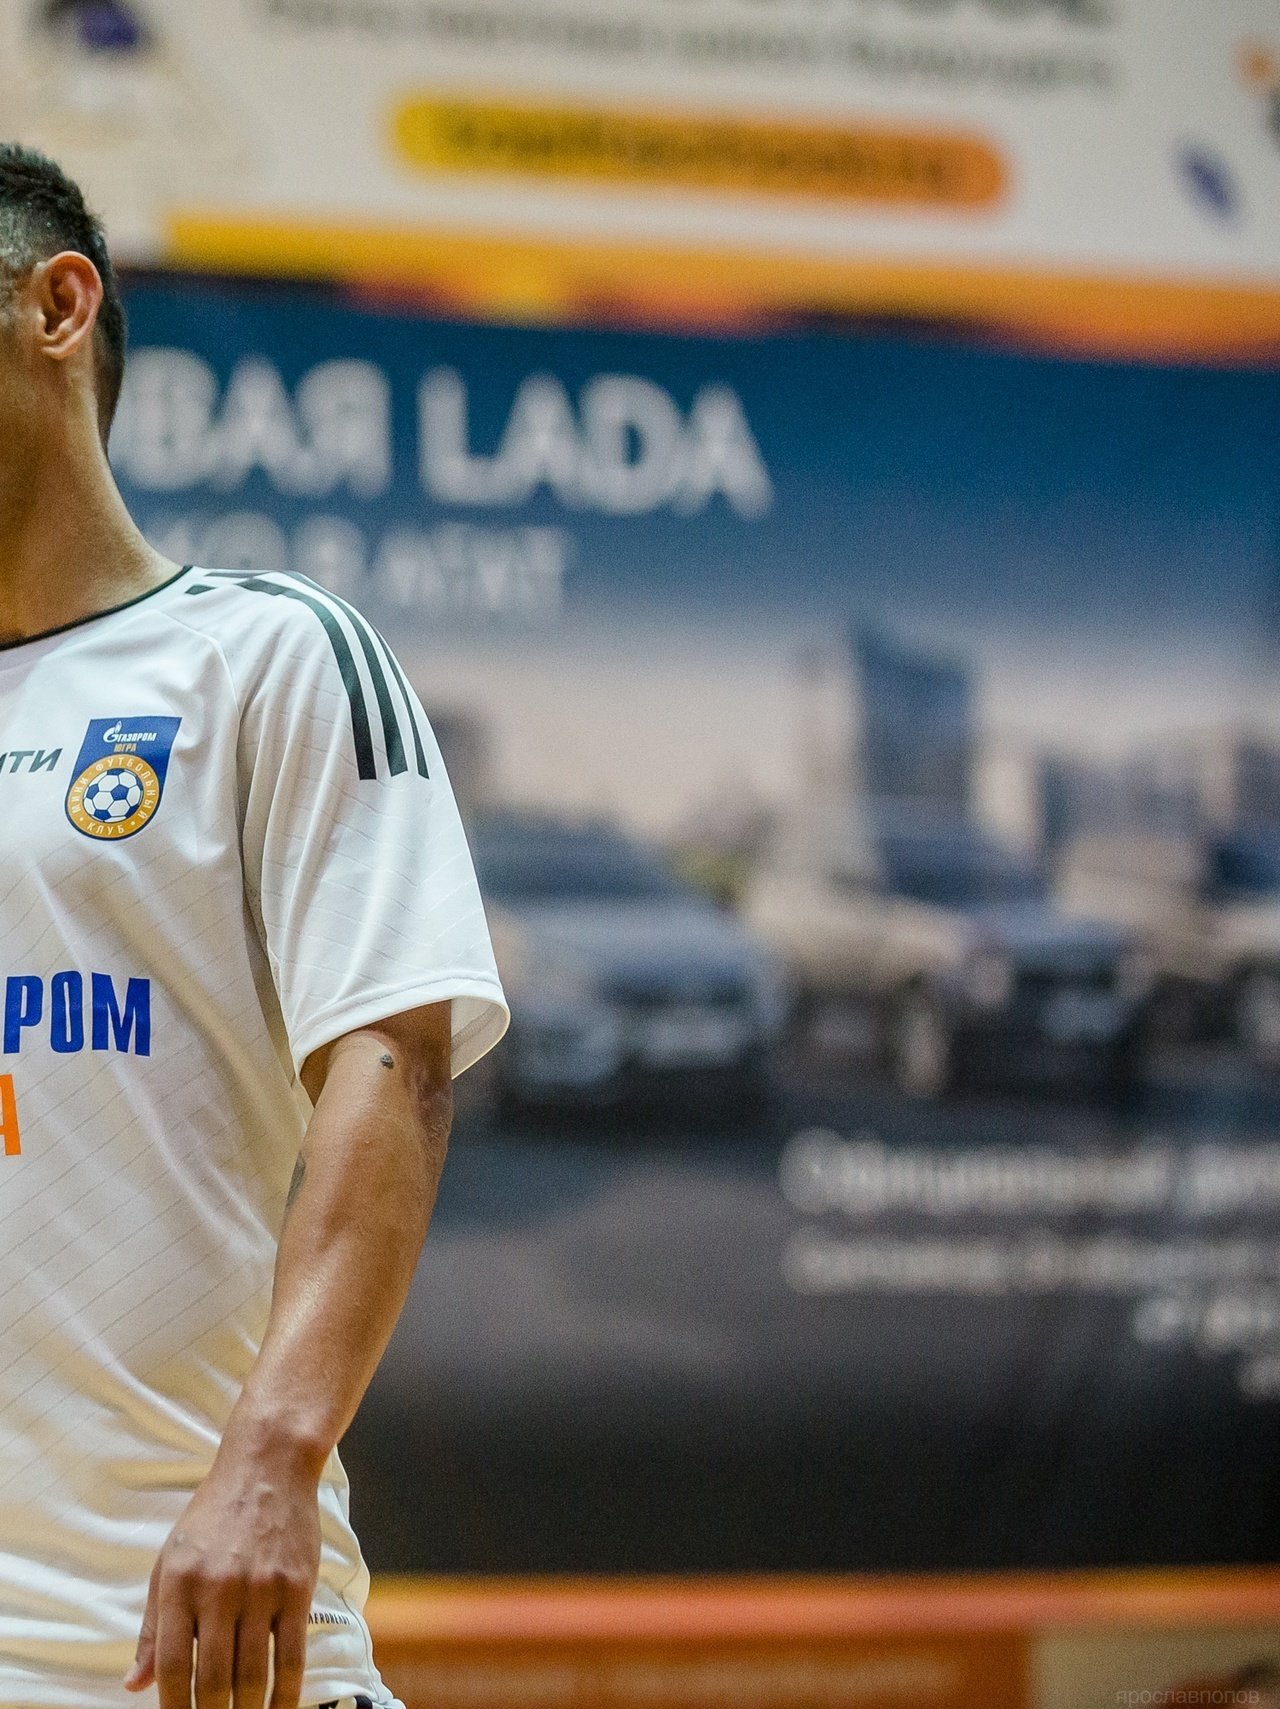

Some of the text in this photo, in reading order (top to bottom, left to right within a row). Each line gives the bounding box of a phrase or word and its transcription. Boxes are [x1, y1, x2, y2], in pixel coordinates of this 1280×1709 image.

[107, 346, 776, 522] ВАЯ LADA
[86, 821, 125, 835] КЛУБ
